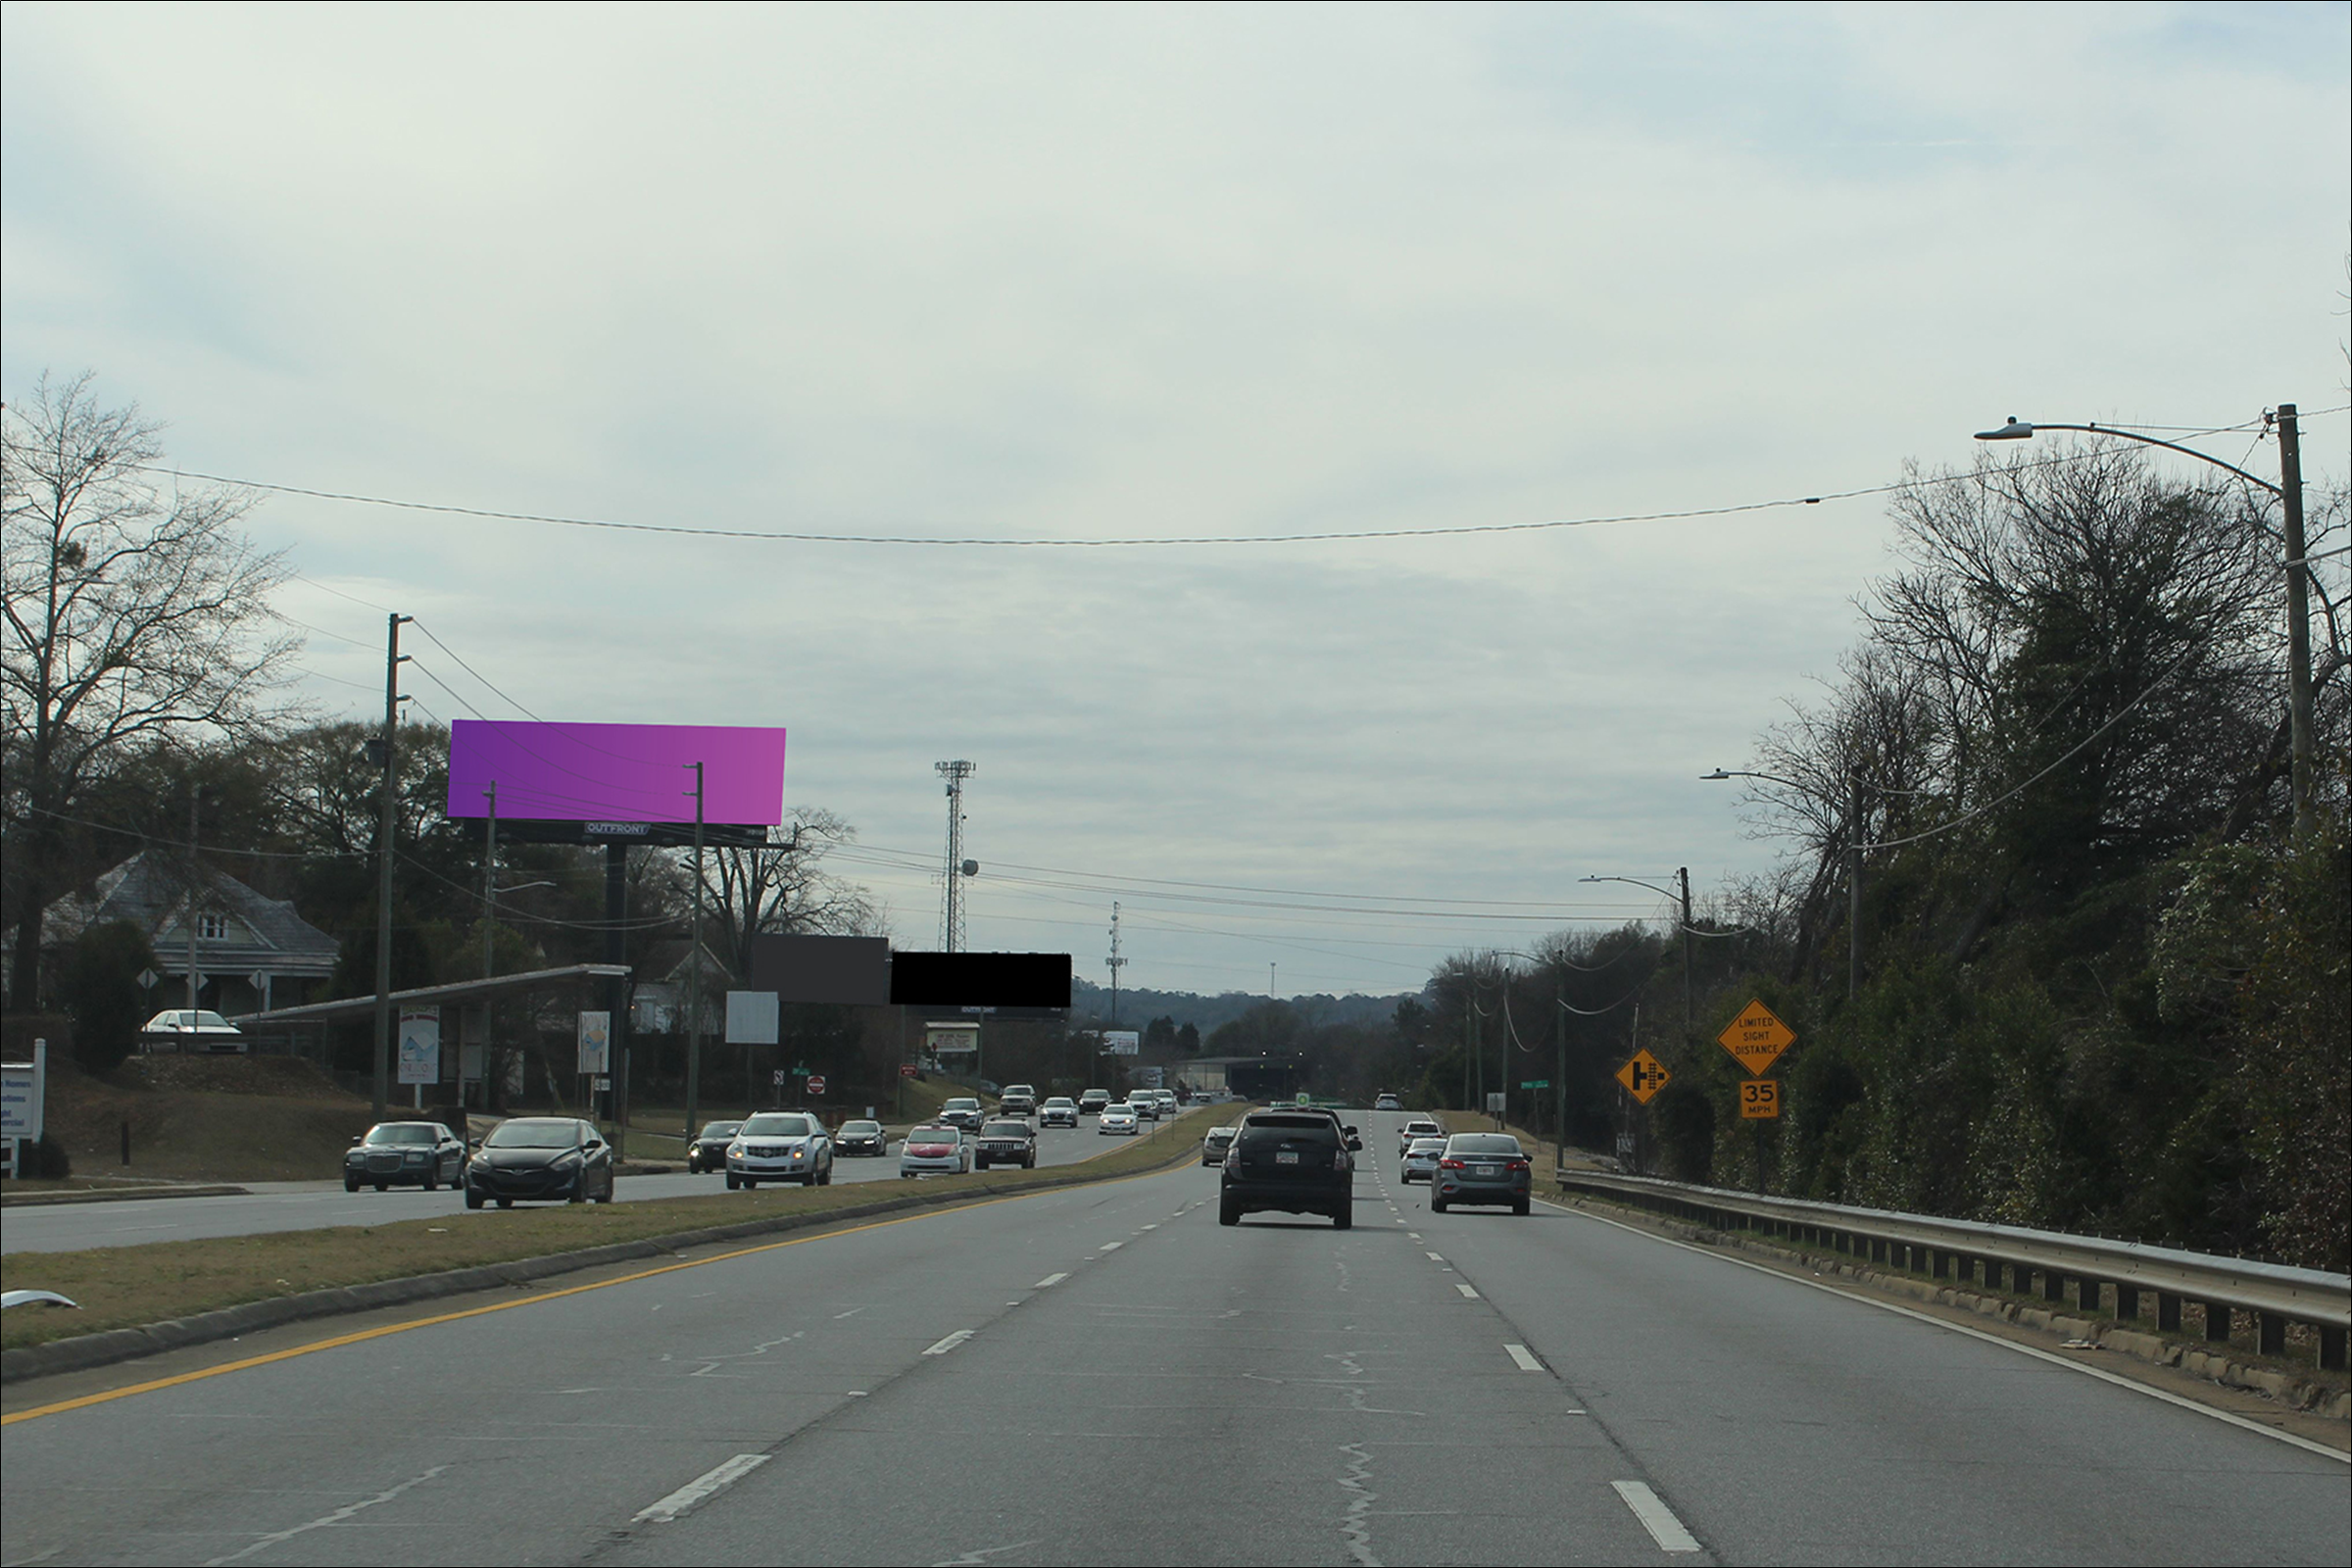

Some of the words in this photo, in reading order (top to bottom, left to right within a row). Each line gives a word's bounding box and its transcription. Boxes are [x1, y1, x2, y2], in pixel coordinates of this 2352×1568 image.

[587, 823, 648, 834] OUTFRONT
[1739, 1017, 1774, 1028] LIMITED
[1743, 1031, 1769, 1042] SIGHT
[1736, 1044, 1779, 1055] DISTANCE
[1744, 1085, 1774, 1102] 35
